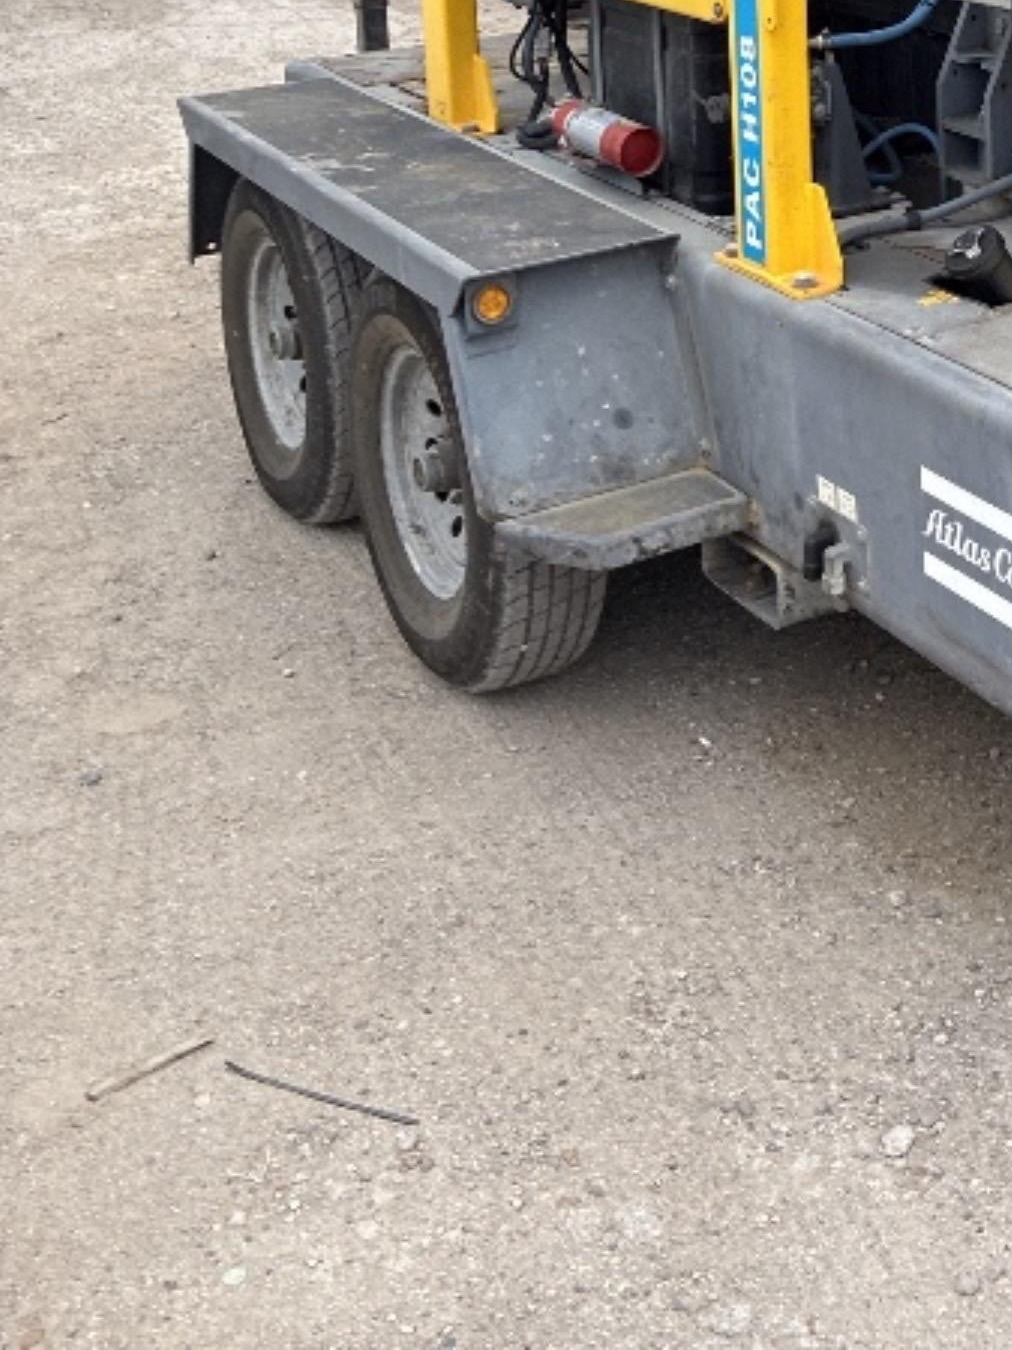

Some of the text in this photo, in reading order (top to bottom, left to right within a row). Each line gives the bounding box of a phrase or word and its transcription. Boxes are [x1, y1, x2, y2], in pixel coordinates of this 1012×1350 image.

[740, 35, 763, 250] PAC H108
[921, 509, 991, 572] Atlas
